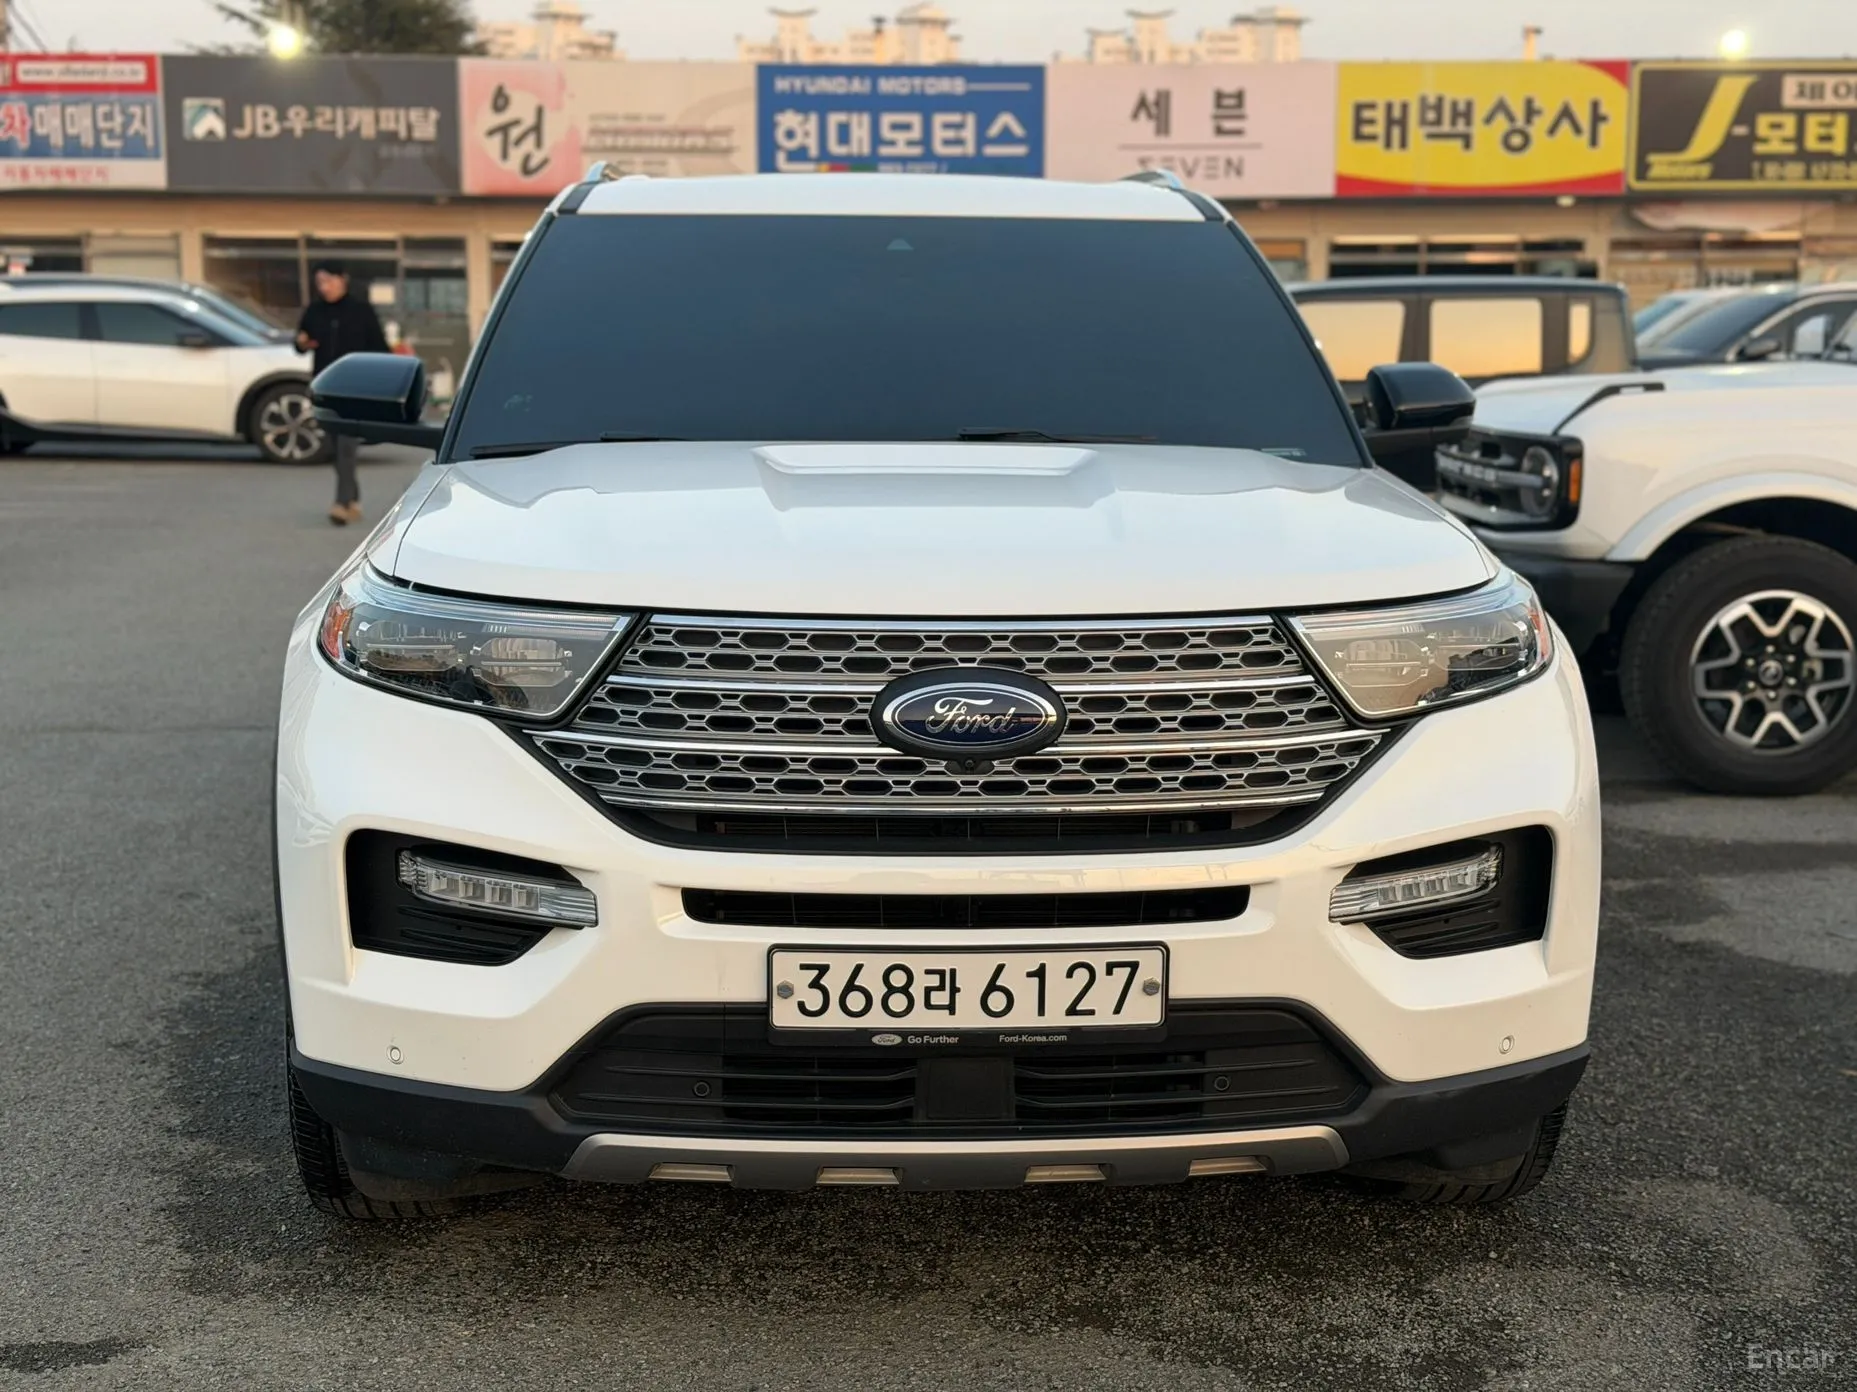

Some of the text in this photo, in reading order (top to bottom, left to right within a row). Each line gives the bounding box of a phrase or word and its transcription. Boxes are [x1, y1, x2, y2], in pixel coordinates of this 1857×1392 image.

[774, 76, 967, 95] HYUNDAI MOTORS
[233, 104, 440, 141] JB우리캐피탈
[485, 84, 550, 180] 원
[773, 109, 1029, 172] 현대모터스
[1351, 94, 1609, 155] 태백상사
[925, 696, 1018, 734] Ford
[797, 960, 1140, 1018] 368라 6127
[907, 1035, 922, 1044] Go
[923, 1035, 959, 1044] Further
[999, 1034, 1067, 1043] Ford-Korea.com
